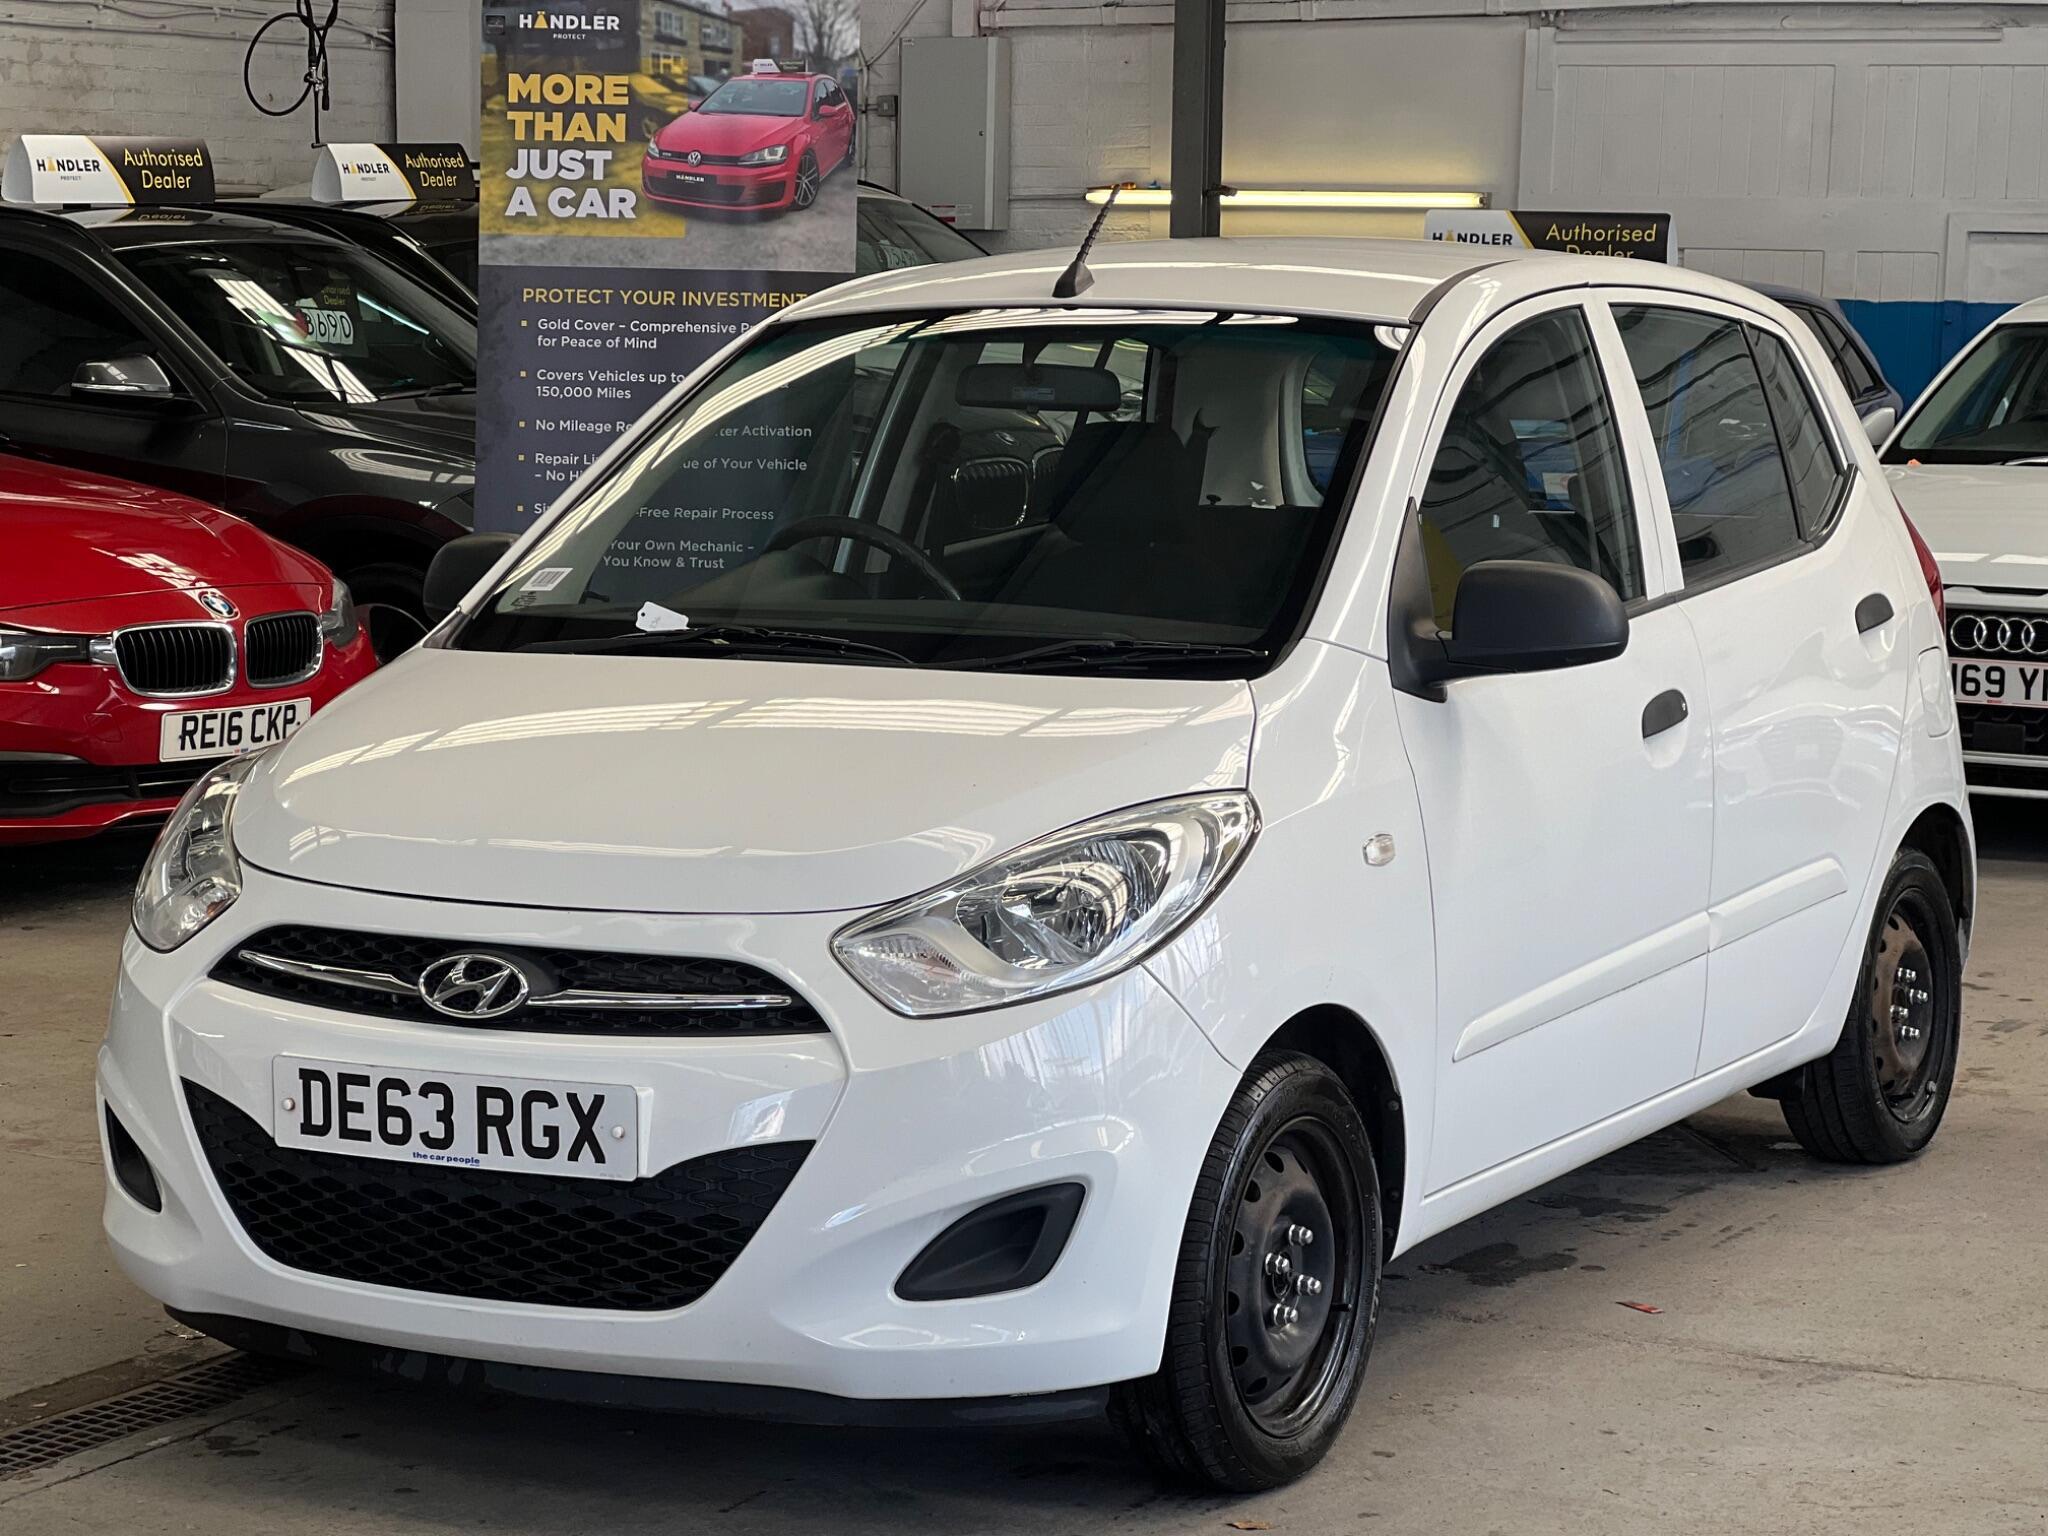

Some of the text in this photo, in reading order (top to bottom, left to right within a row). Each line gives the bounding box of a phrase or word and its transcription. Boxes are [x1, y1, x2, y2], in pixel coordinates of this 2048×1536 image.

[507, 73, 630, 105] MORE
[506, 111, 626, 142] THAN
[123, 147, 204, 167] Authorised
[404, 152, 465, 169] Authorised
[504, 148, 613, 181] JUST
[141, 169, 192, 189] Dealer
[420, 170, 458, 187] Dealer
[504, 186, 637, 219] A CAR
[1545, 222, 1657, 242] Authorised
[523, 288, 614, 304] PROTECT
[619, 290, 676, 306] YOUR
[537, 318, 570, 330] Gold
[574, 319, 615, 331] Cover
[630, 319, 737, 336] Comprehensive
[537, 335, 657, 349] for Peace of Mind
[536, 369, 685, 385] Covers Vehicles up to
[536, 386, 632, 399] 150,000 Miles
[535, 420, 555, 431] No
[559, 420, 612, 434] Mileage
[741, 425, 812, 437] Activation
[535, 453, 580, 466] Repair
[703, 457, 718, 469] of
[720, 458, 753, 469] Your
[757, 458, 808, 471] Vehicle
[546, 470, 565, 481] No
[674, 507, 719, 521] Repair
[722, 508, 775, 520] Process
[611, 540, 641, 551] Your
[645, 540, 676, 551] Own
[680, 540, 743, 553] Mechanic
[603, 555, 725, 569] You Know & Trust
[179, 704, 297, 751] RE16 CKP
[298, 1067, 606, 1164] DE63 RGX
[412, 1152, 428, 1160] the
[446, 1156, 480, 1165] people
